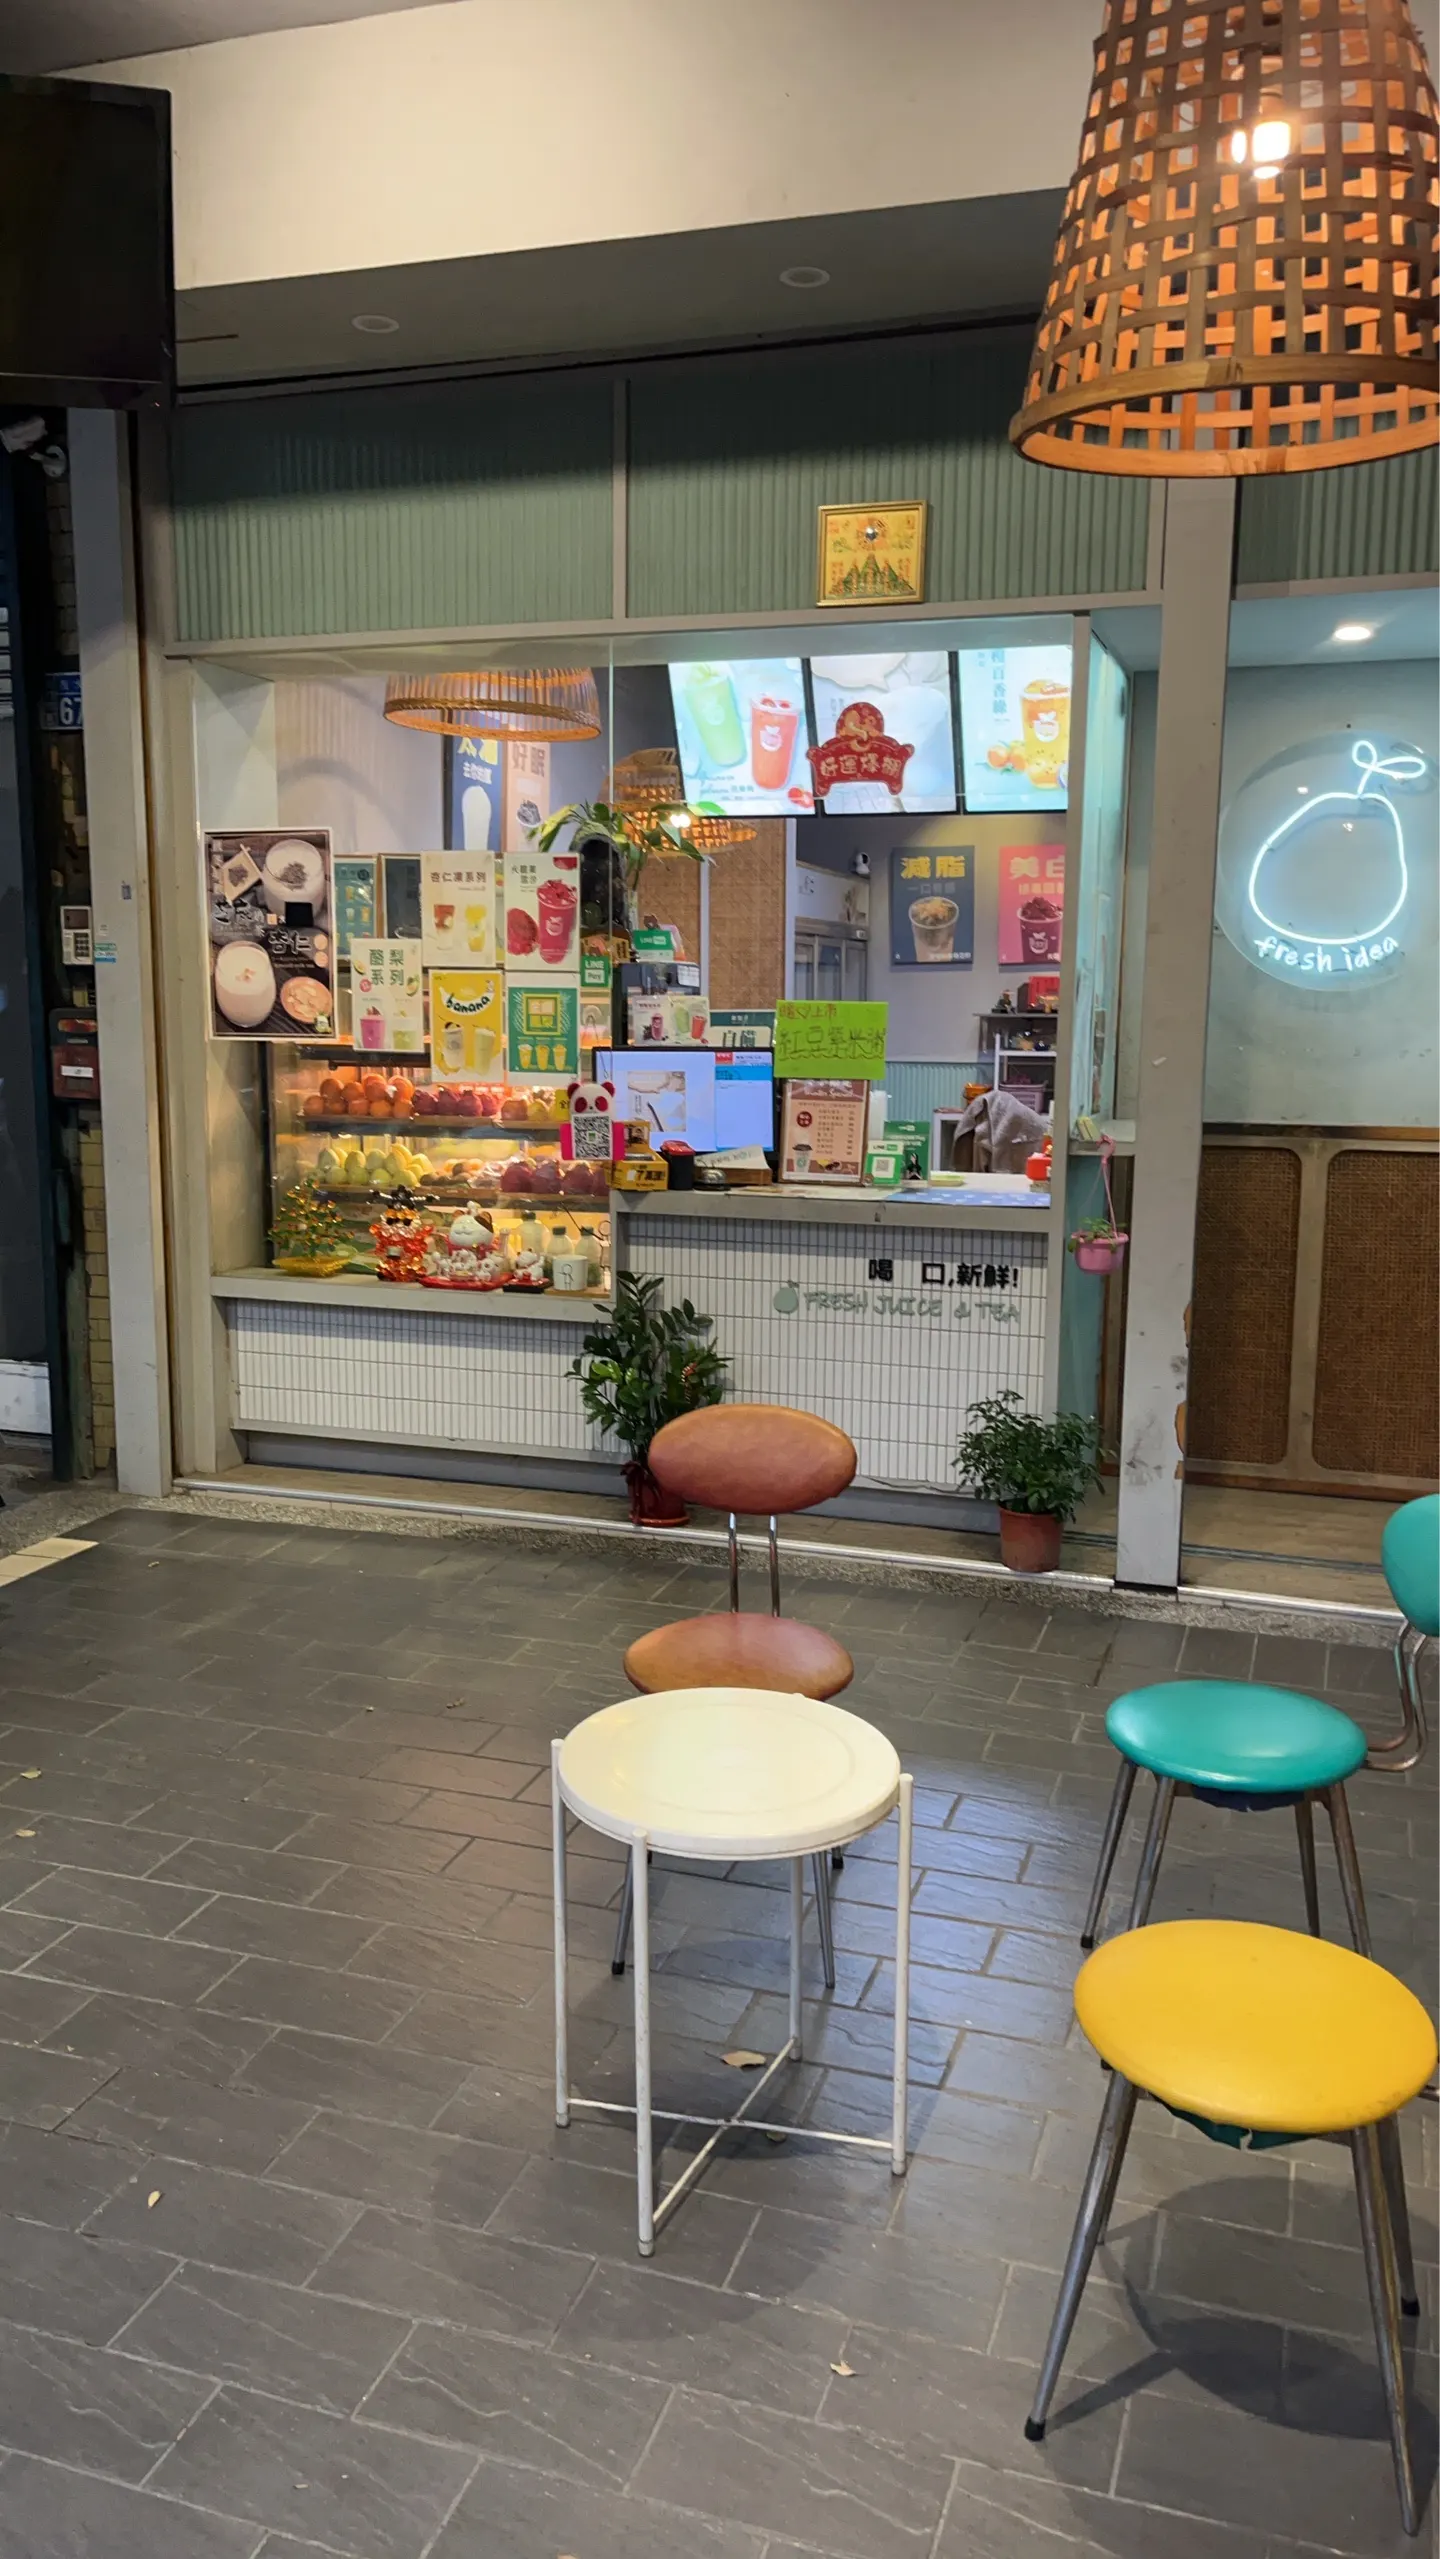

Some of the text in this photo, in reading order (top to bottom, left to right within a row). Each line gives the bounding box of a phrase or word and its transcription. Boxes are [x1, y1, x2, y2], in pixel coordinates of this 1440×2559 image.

[900, 855, 966, 879] 減脂
[585, 960, 605, 969] LINE
[1254, 935, 1399, 973] fresh idea
[445, 992, 491, 1013] banana
[868, 1259, 1019, 1289] 喝 口,新鮮!
[804, 1291, 1021, 1324] FRESH JUICE & TEA
